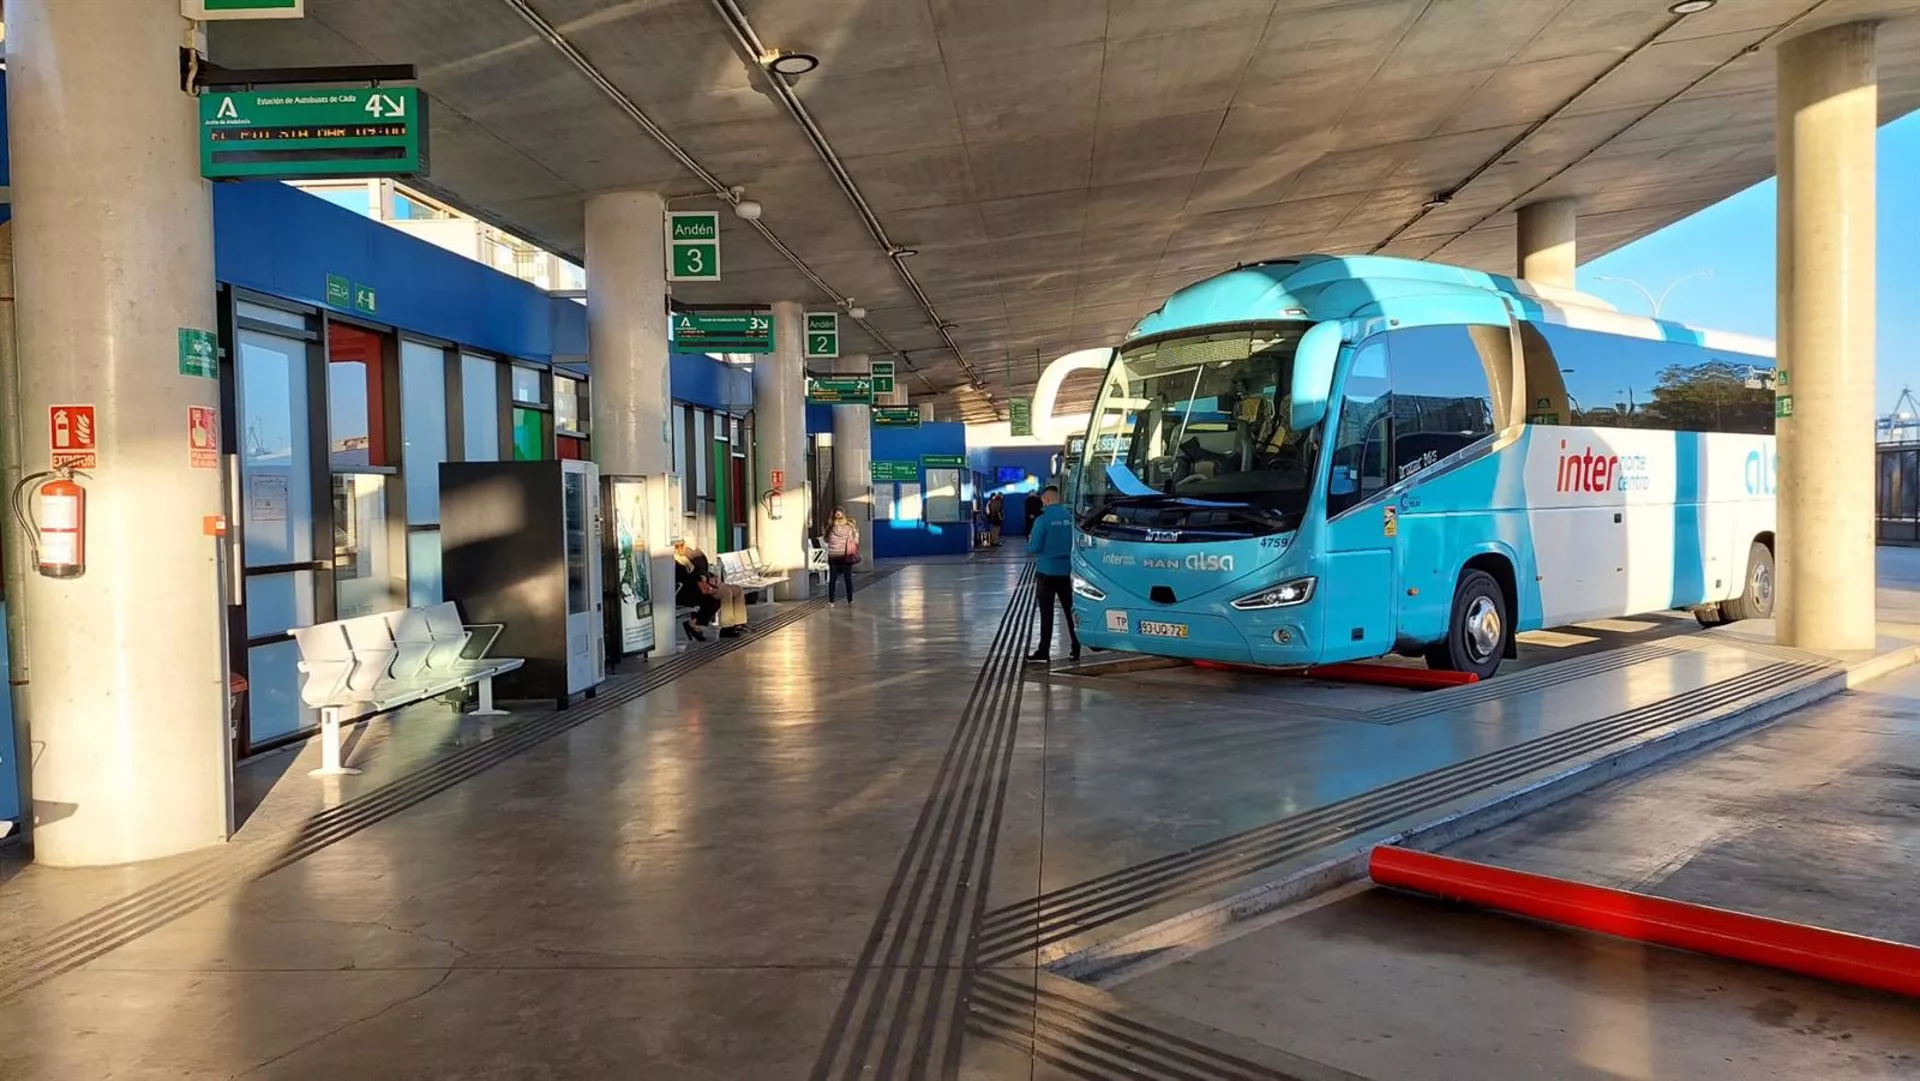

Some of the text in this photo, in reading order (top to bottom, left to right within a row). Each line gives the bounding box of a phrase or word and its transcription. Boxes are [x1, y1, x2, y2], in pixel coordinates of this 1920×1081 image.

[256, 96, 284, 106] Estación
[294, 95, 329, 104] Autobuses
[364, 94, 384, 118] 4
[674, 222, 714, 236] Andén
[686, 248, 704, 274] 3
[749, 317, 759, 330] 3
[809, 319, 835, 329] Andén
[816, 336, 829, 353] 2
[880, 379, 887, 391] 1
[1556, 439, 1618, 492] inter
[1260, 537, 1289, 548] 4759
[1102, 552, 1124, 565] inter
[1143, 559, 1180, 569] MAN
[1185, 551, 1234, 571] alsa
[1116, 616, 1127, 627] TP
